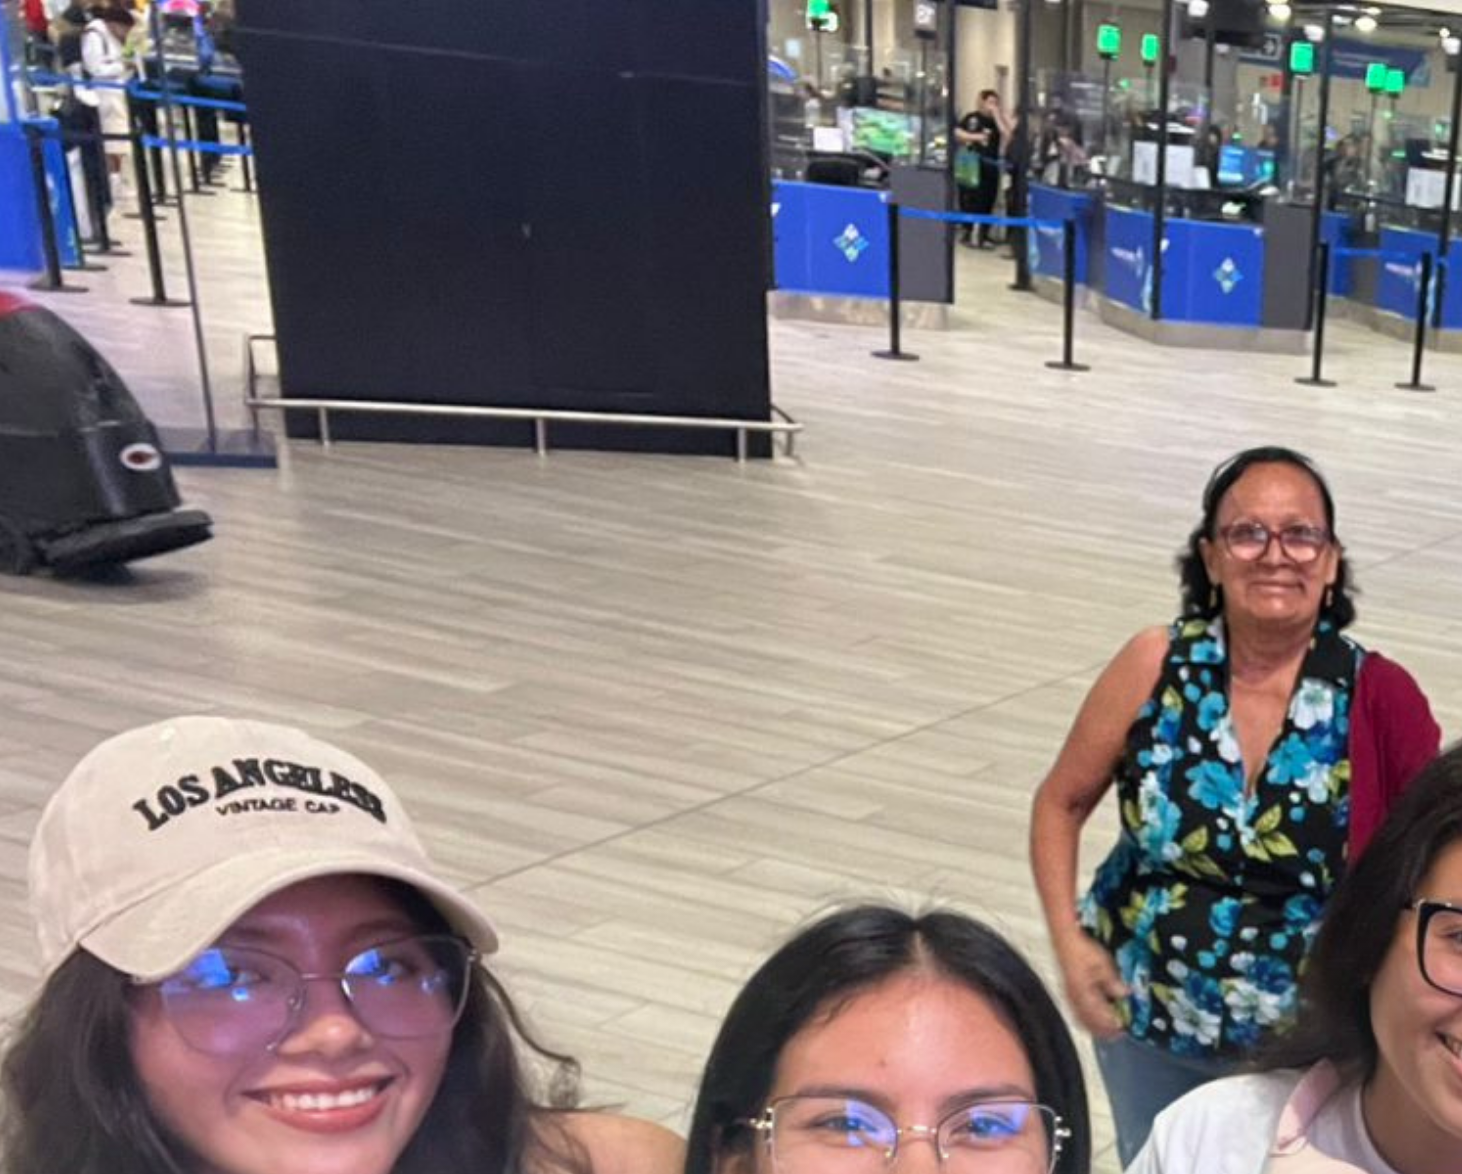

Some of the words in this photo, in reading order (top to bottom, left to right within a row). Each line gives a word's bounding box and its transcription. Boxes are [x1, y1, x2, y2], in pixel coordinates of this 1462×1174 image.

[132, 774, 210, 831] LOS
[215, 798, 298, 816] VINTAGE
[304, 801, 340, 813] CAP
